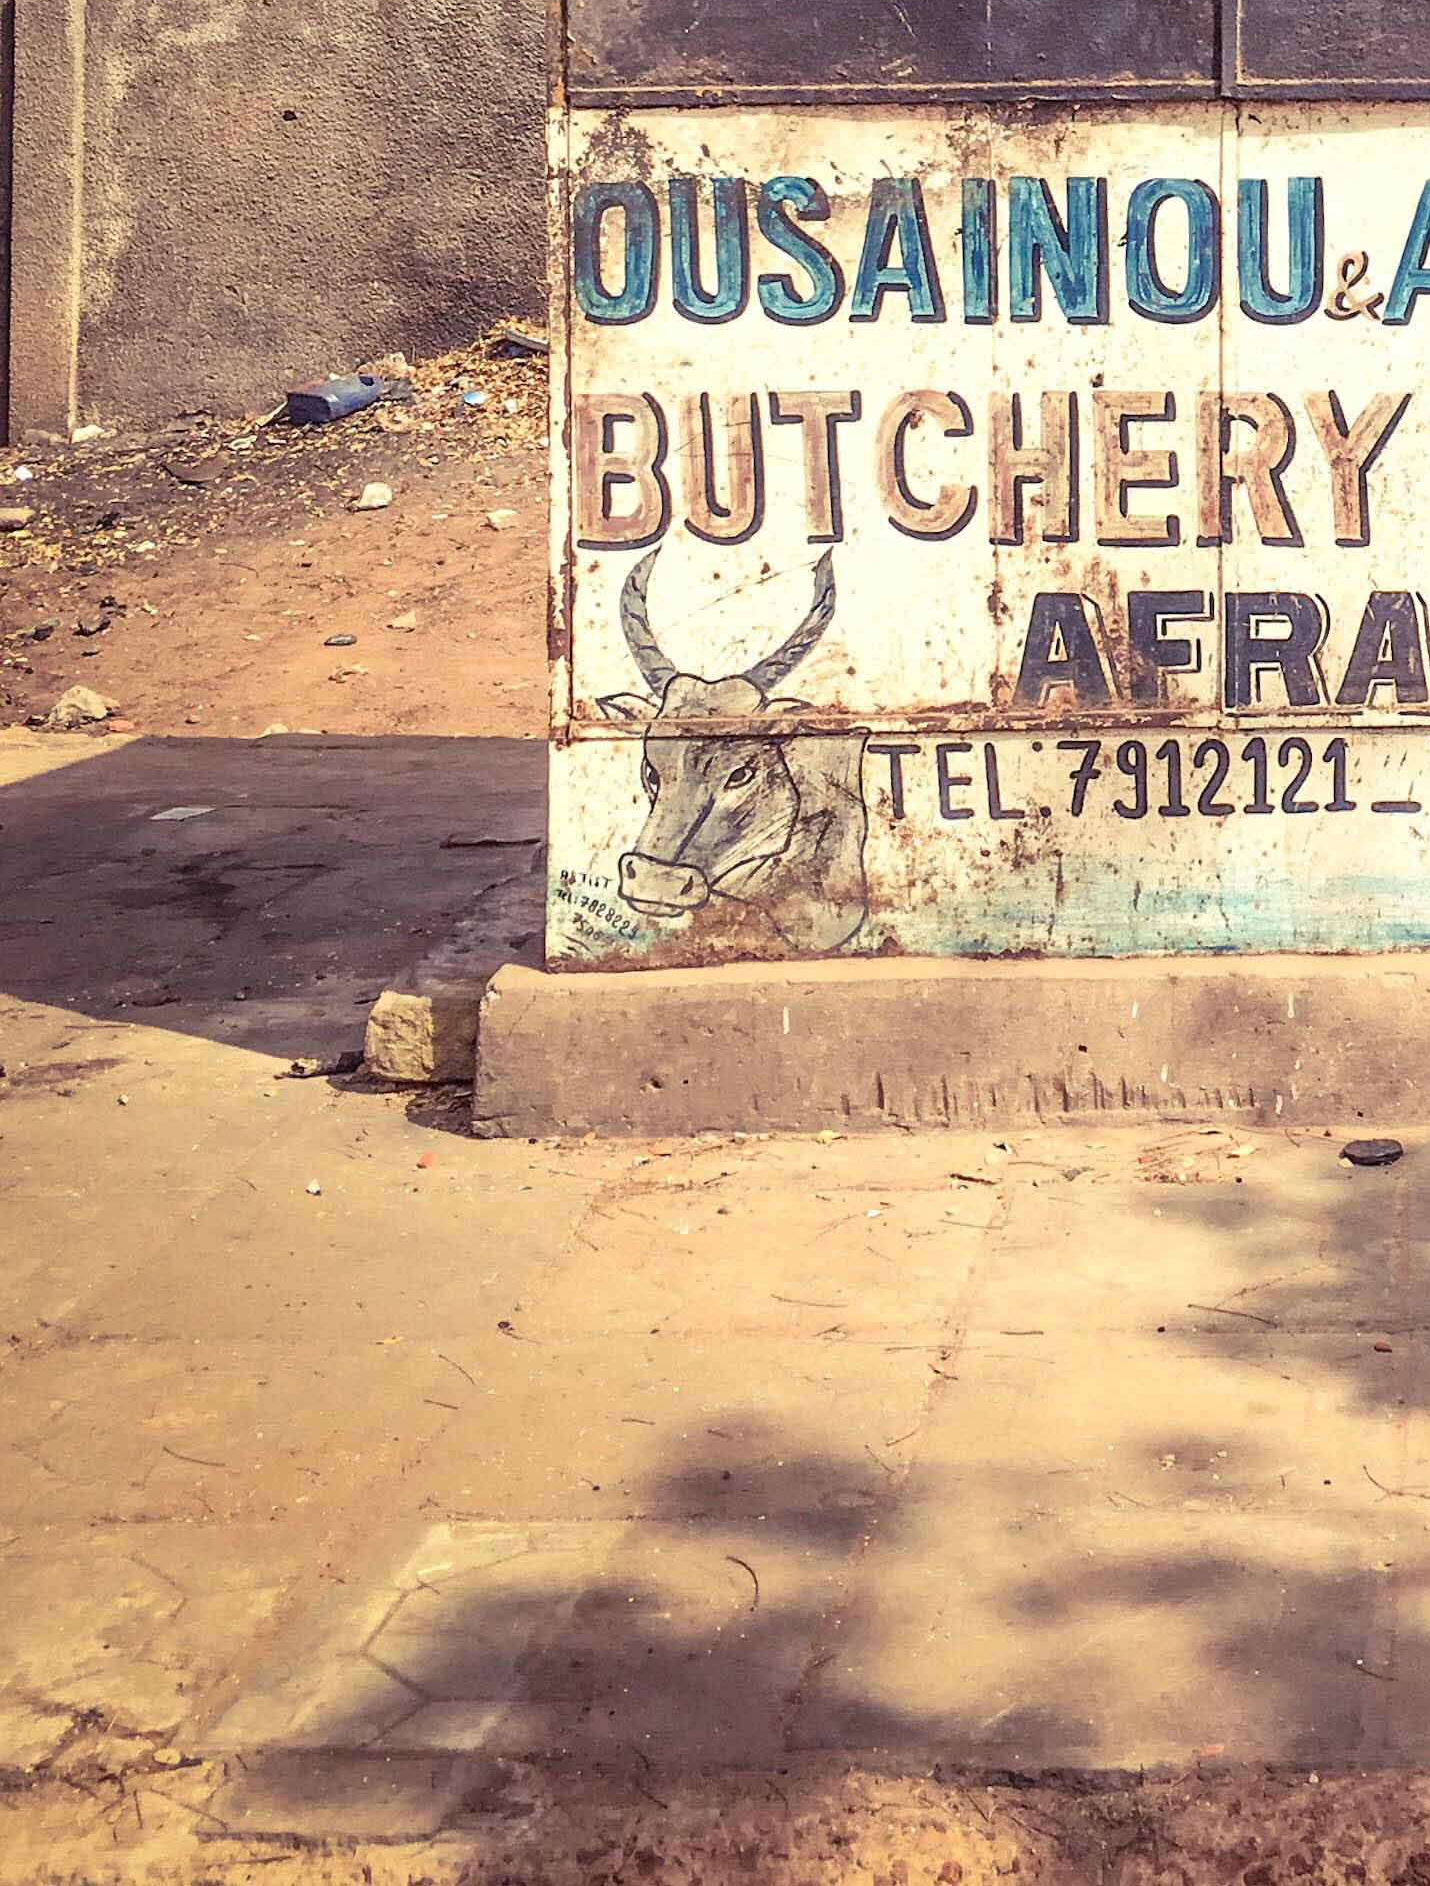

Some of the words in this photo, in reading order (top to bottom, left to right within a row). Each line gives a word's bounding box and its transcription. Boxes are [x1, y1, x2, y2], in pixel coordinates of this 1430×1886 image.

[573, 175, 1324, 326] OUSAINOU
[1324, 250, 1385, 322] &
[574, 389, 1412, 551] BUTCHERY
